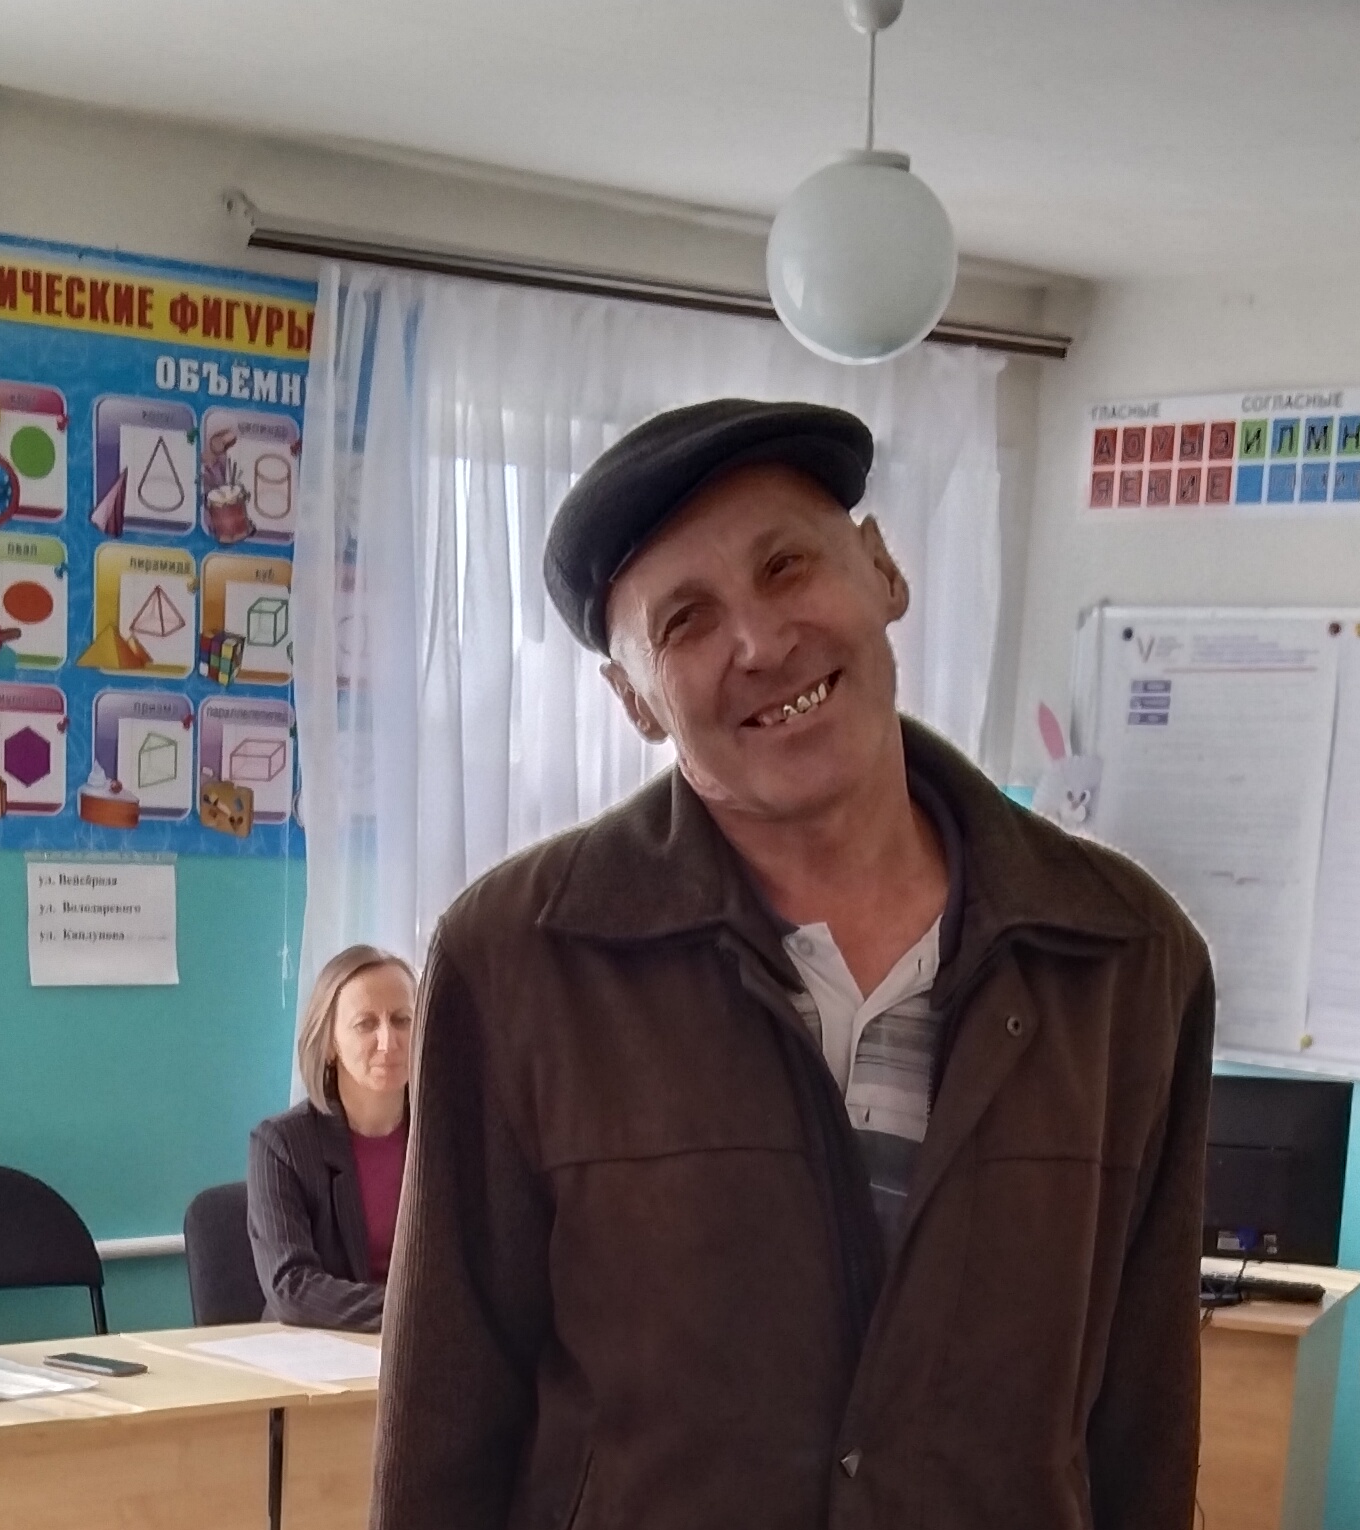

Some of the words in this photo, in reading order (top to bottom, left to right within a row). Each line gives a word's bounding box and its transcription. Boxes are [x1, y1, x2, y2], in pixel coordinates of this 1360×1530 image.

[156, 355, 308, 407] ОБЪЁМН
[1306, 425, 1328, 452] М
[1342, 424, 1360, 450] Н
